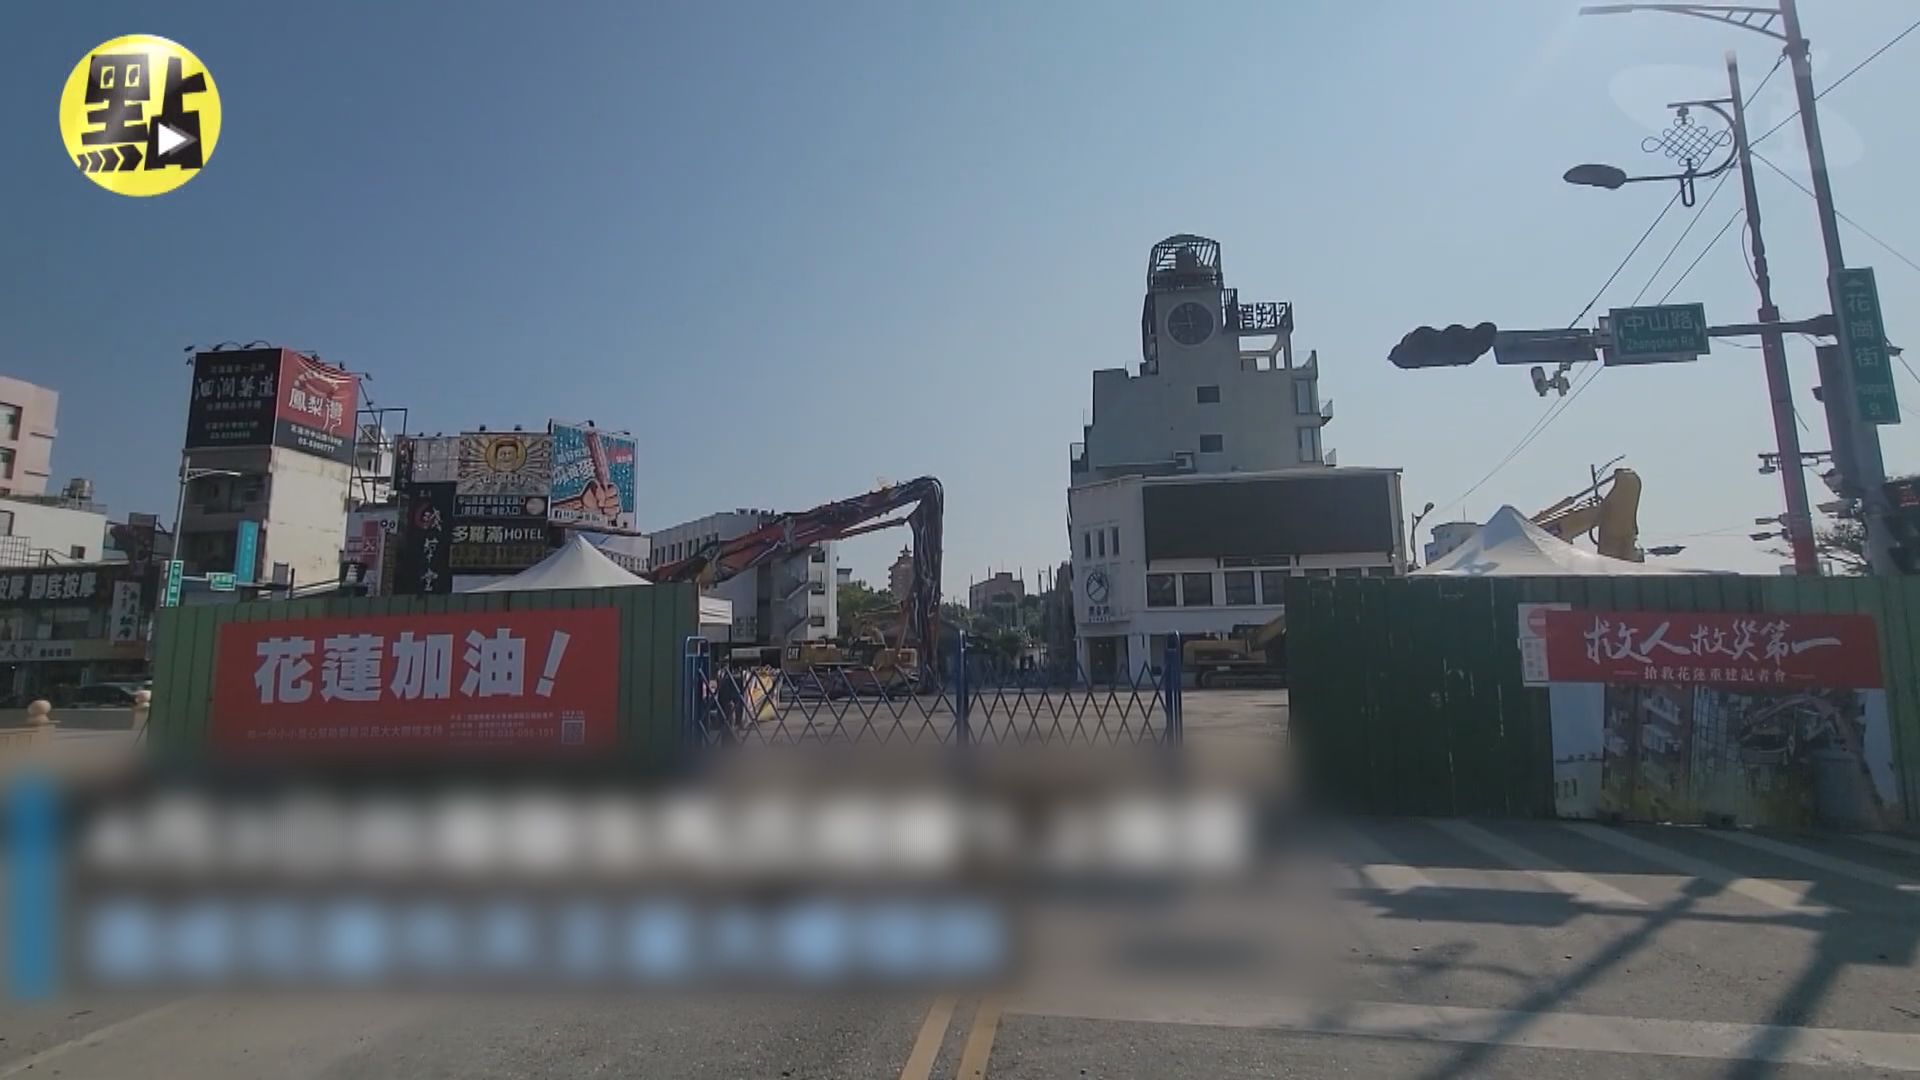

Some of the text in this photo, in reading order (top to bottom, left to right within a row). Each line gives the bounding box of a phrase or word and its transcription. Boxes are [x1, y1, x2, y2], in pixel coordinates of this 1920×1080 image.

[1623, 311, 1694, 334] 中山路
[288, 388, 343, 435] 鳳梨灣
[1584, 615, 1842, 666] 救人救災第一
[253, 627, 572, 705] 花蓮加油!
[1643, 665, 1787, 683] 搶救花蓮重建記者會
